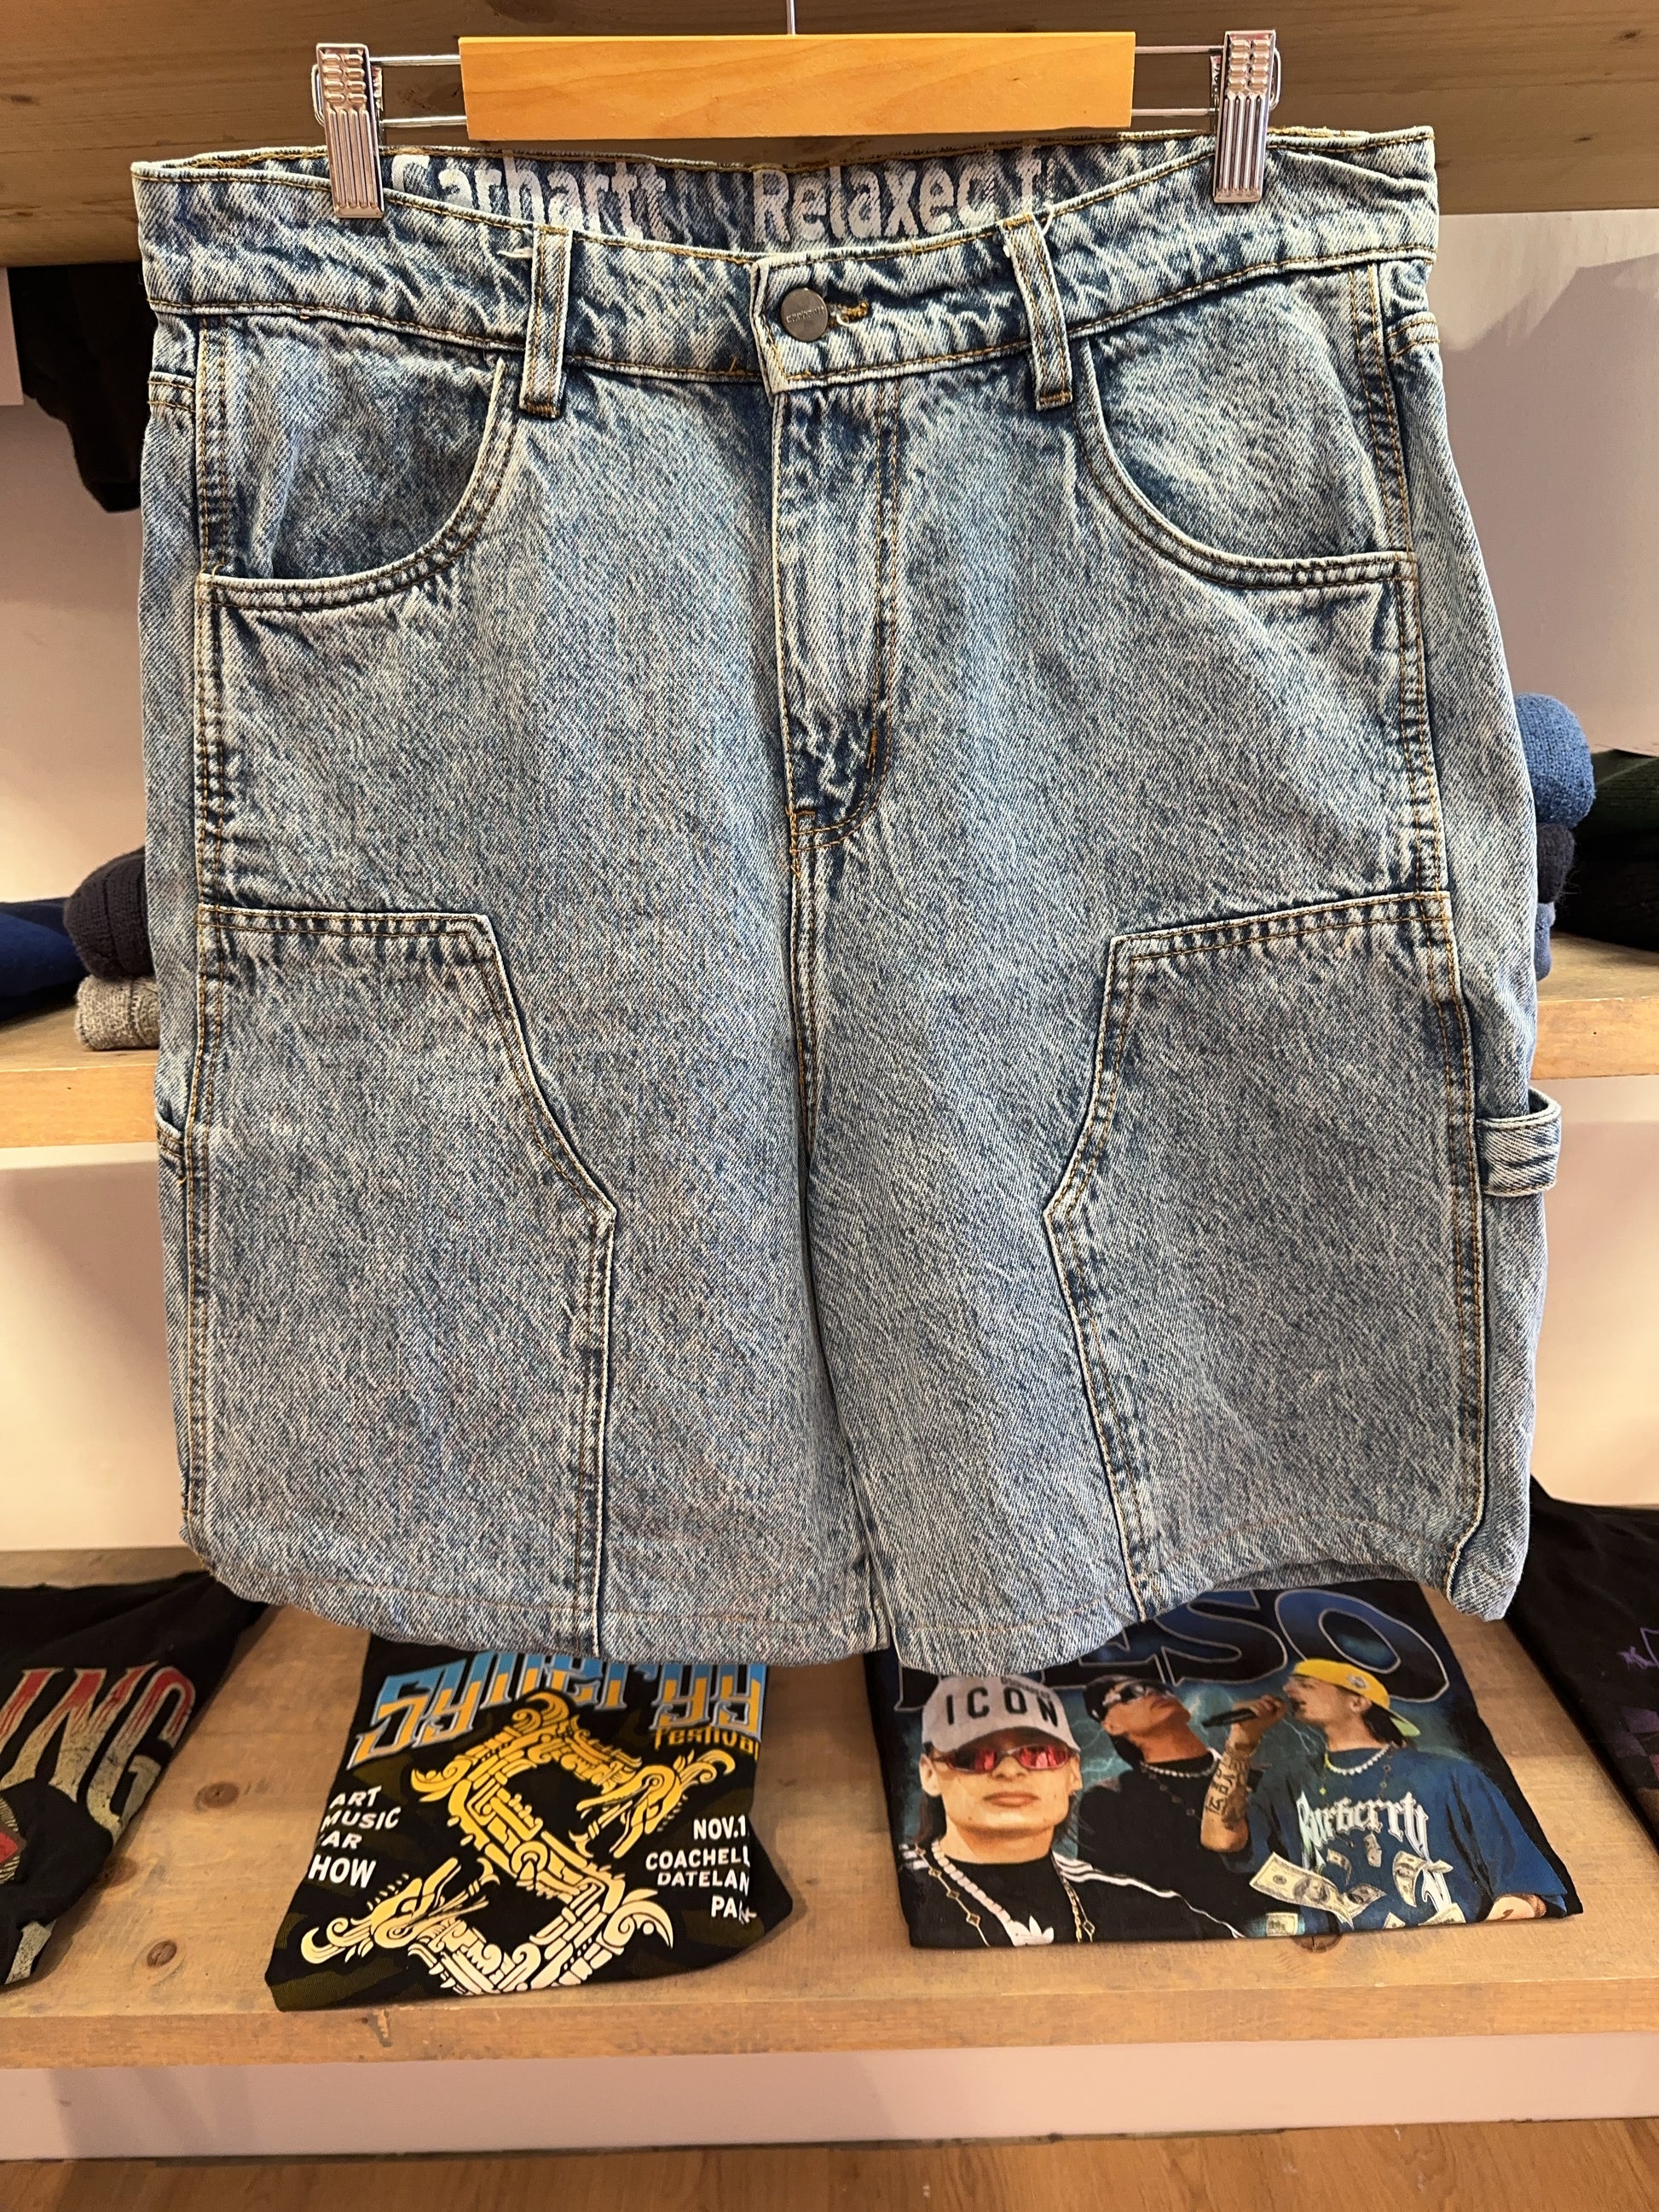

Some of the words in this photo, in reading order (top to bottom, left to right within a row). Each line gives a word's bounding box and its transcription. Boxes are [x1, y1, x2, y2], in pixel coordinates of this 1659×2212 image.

[946, 1686, 1058, 1727] ICON
[329, 1785, 382, 1810] ART
[320, 1806, 402, 1833] MUSIC
[316, 1830, 362, 1850] AR
